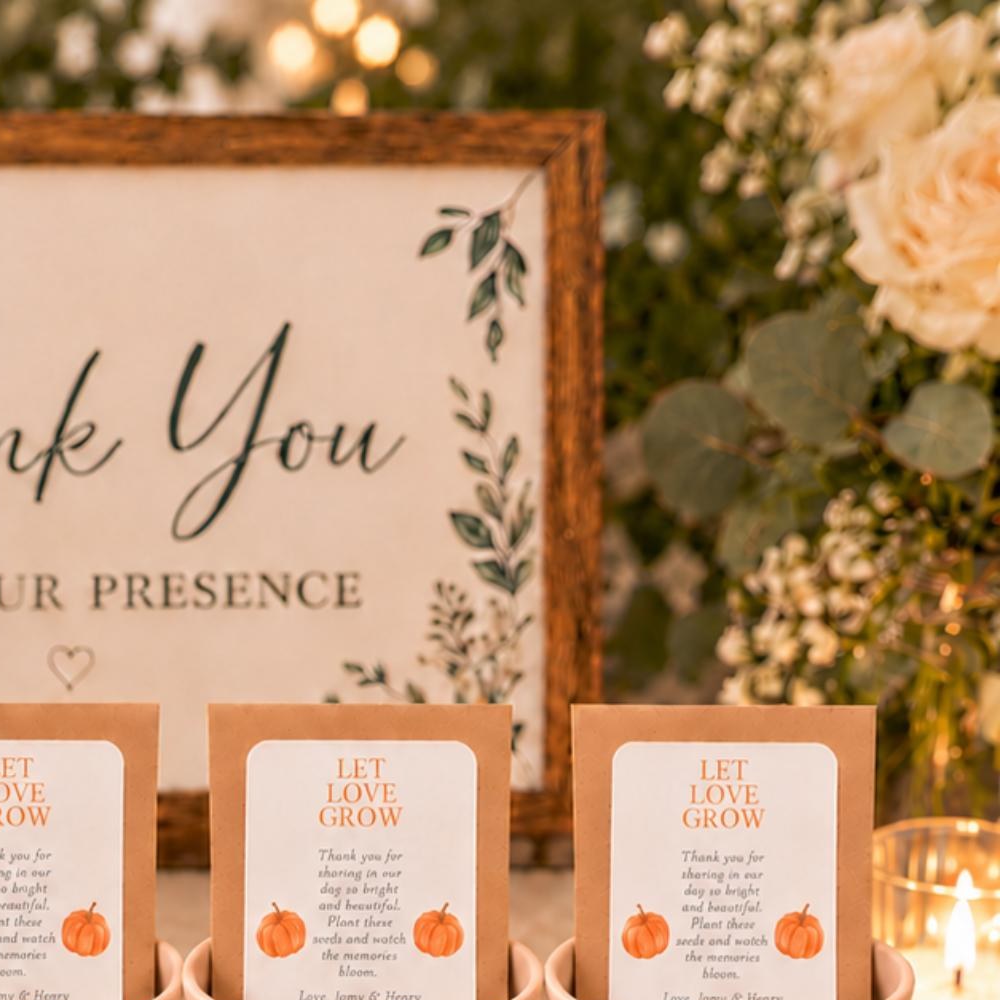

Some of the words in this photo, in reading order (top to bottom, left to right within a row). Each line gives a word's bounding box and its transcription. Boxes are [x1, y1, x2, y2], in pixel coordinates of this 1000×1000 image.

[167, 321, 406, 541] You
[91, 571, 363, 612] PRESENCE
[338, 757, 386, 779] LET
[700, 759, 748, 781] LET
[327, 782, 397, 803] LOVE
[690, 783, 760, 804] LOVE
[318, 806, 403, 827] GROW
[681, 807, 765, 828] GROW
[9, 852, 30, 864] you
[33, 848, 52, 864] for
[319, 849, 356, 861] Thank
[362, 852, 382, 864] you
[384, 849, 403, 864] for
[682, 850, 720, 863] Thank
[723, 854, 744, 866] you
[746, 850, 764, 866] for
[16, 866, 27, 878] in
[31, 868, 52, 878] our
[320, 882, 342, 897] day
[346, 885, 358, 895] so
[363, 882, 399, 897] bright
[684, 884, 705, 899] day
[709, 887, 722, 897] so
[725, 884, 760, 899] bright
[318, 898, 342, 911] and
[345, 898, 400, 914] beautiful.
[691, 917, 722, 929] Plant
[726, 917, 755, 929] these
[18, 989, 30, 1000] &
